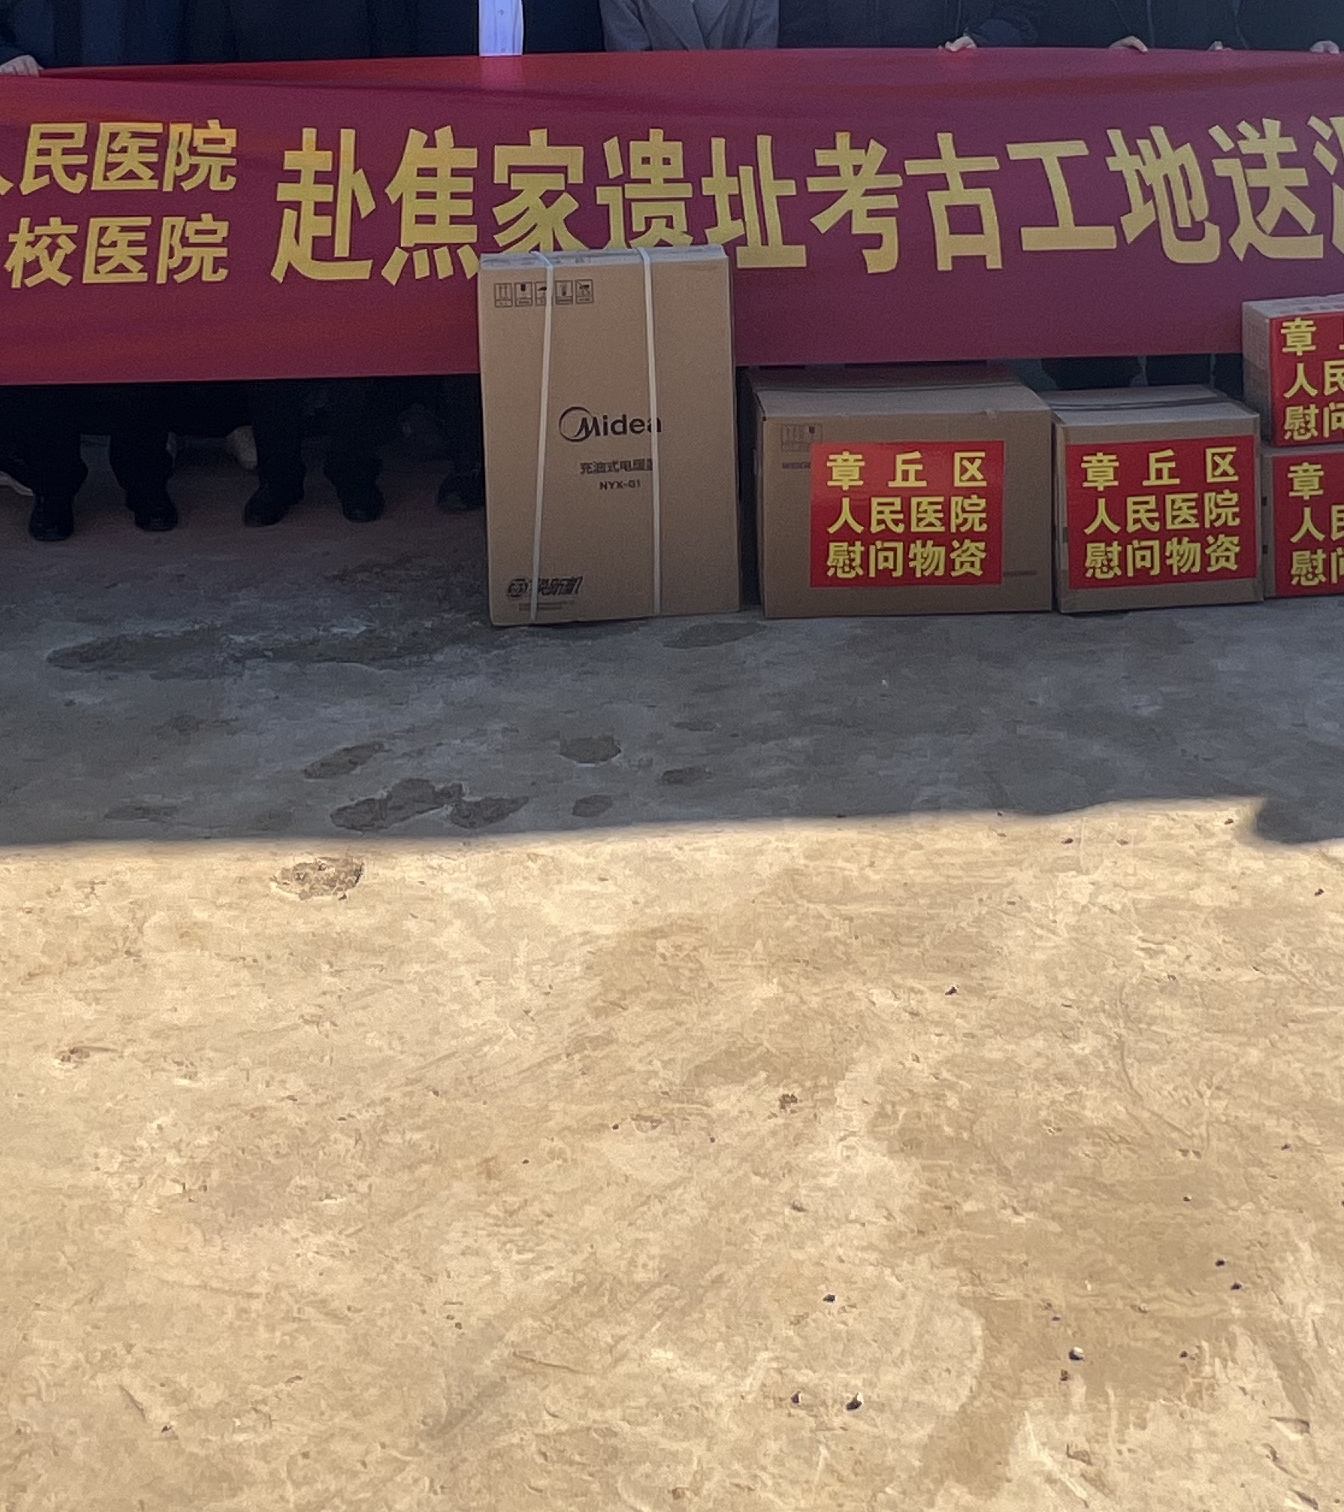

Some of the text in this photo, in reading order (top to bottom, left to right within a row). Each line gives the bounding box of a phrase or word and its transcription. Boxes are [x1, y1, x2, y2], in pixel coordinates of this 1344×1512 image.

[559, 406, 662, 442] Midea
[826, 450, 988, 491] 章丘区
[1080, 446, 1240, 492] 章丘区
[826, 494, 988, 535] 人民医院
[1083, 489, 1241, 536] 人民医院
[826, 538, 988, 579] 慰问物资
[1084, 533, 1241, 580] 慰问物资
